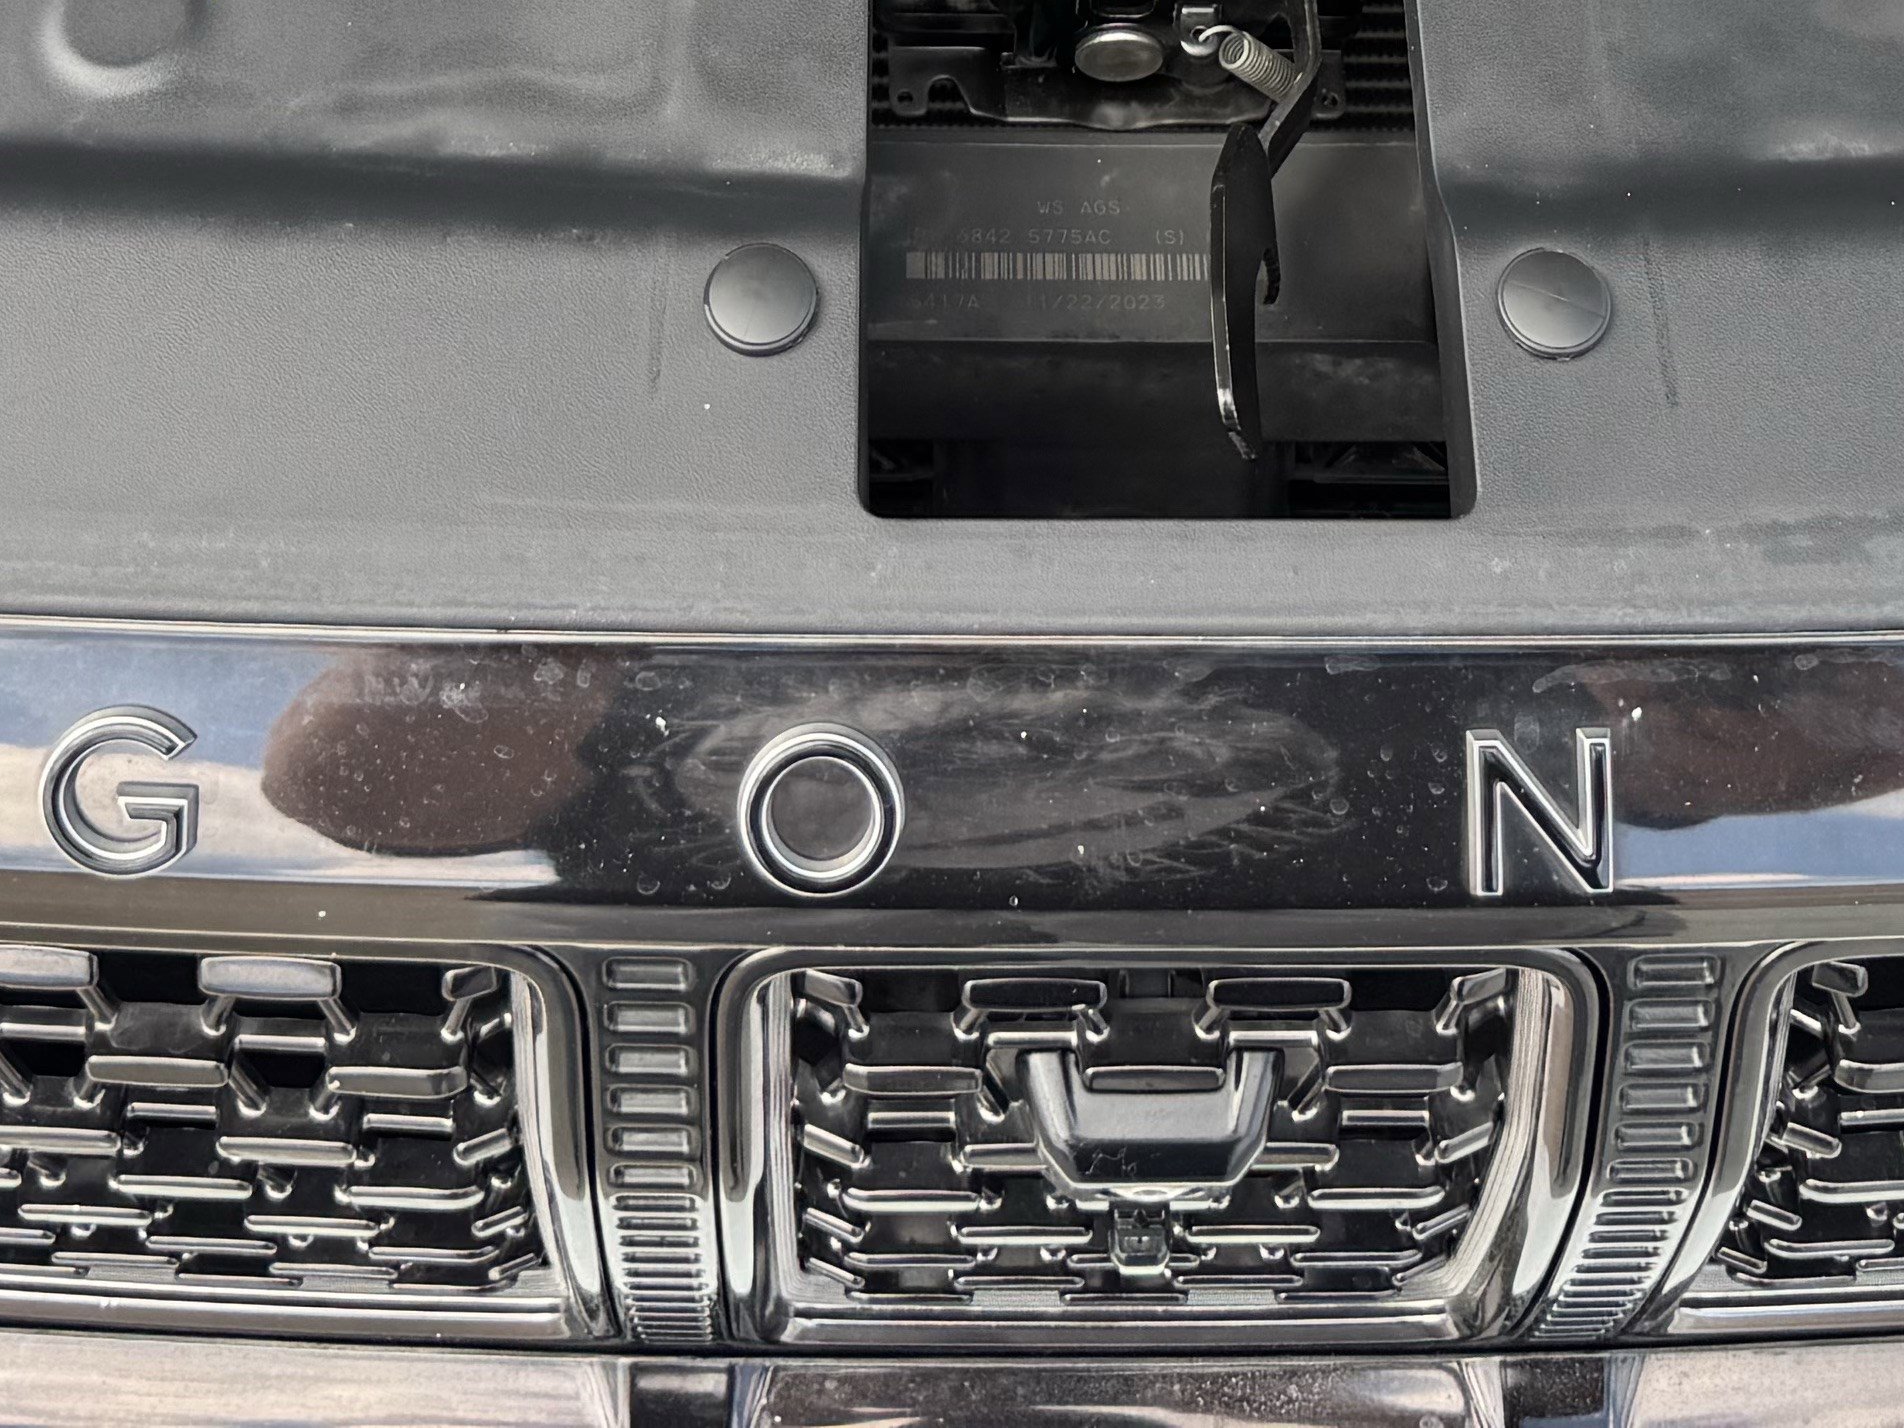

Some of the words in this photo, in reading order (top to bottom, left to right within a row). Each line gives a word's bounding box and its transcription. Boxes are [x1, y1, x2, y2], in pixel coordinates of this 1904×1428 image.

[1037, 200, 1064, 215] WS
[1080, 200, 1121, 215] AGS
[1028, 229, 1112, 245] 5775AC
[1156, 229, 1186, 246] (S)
